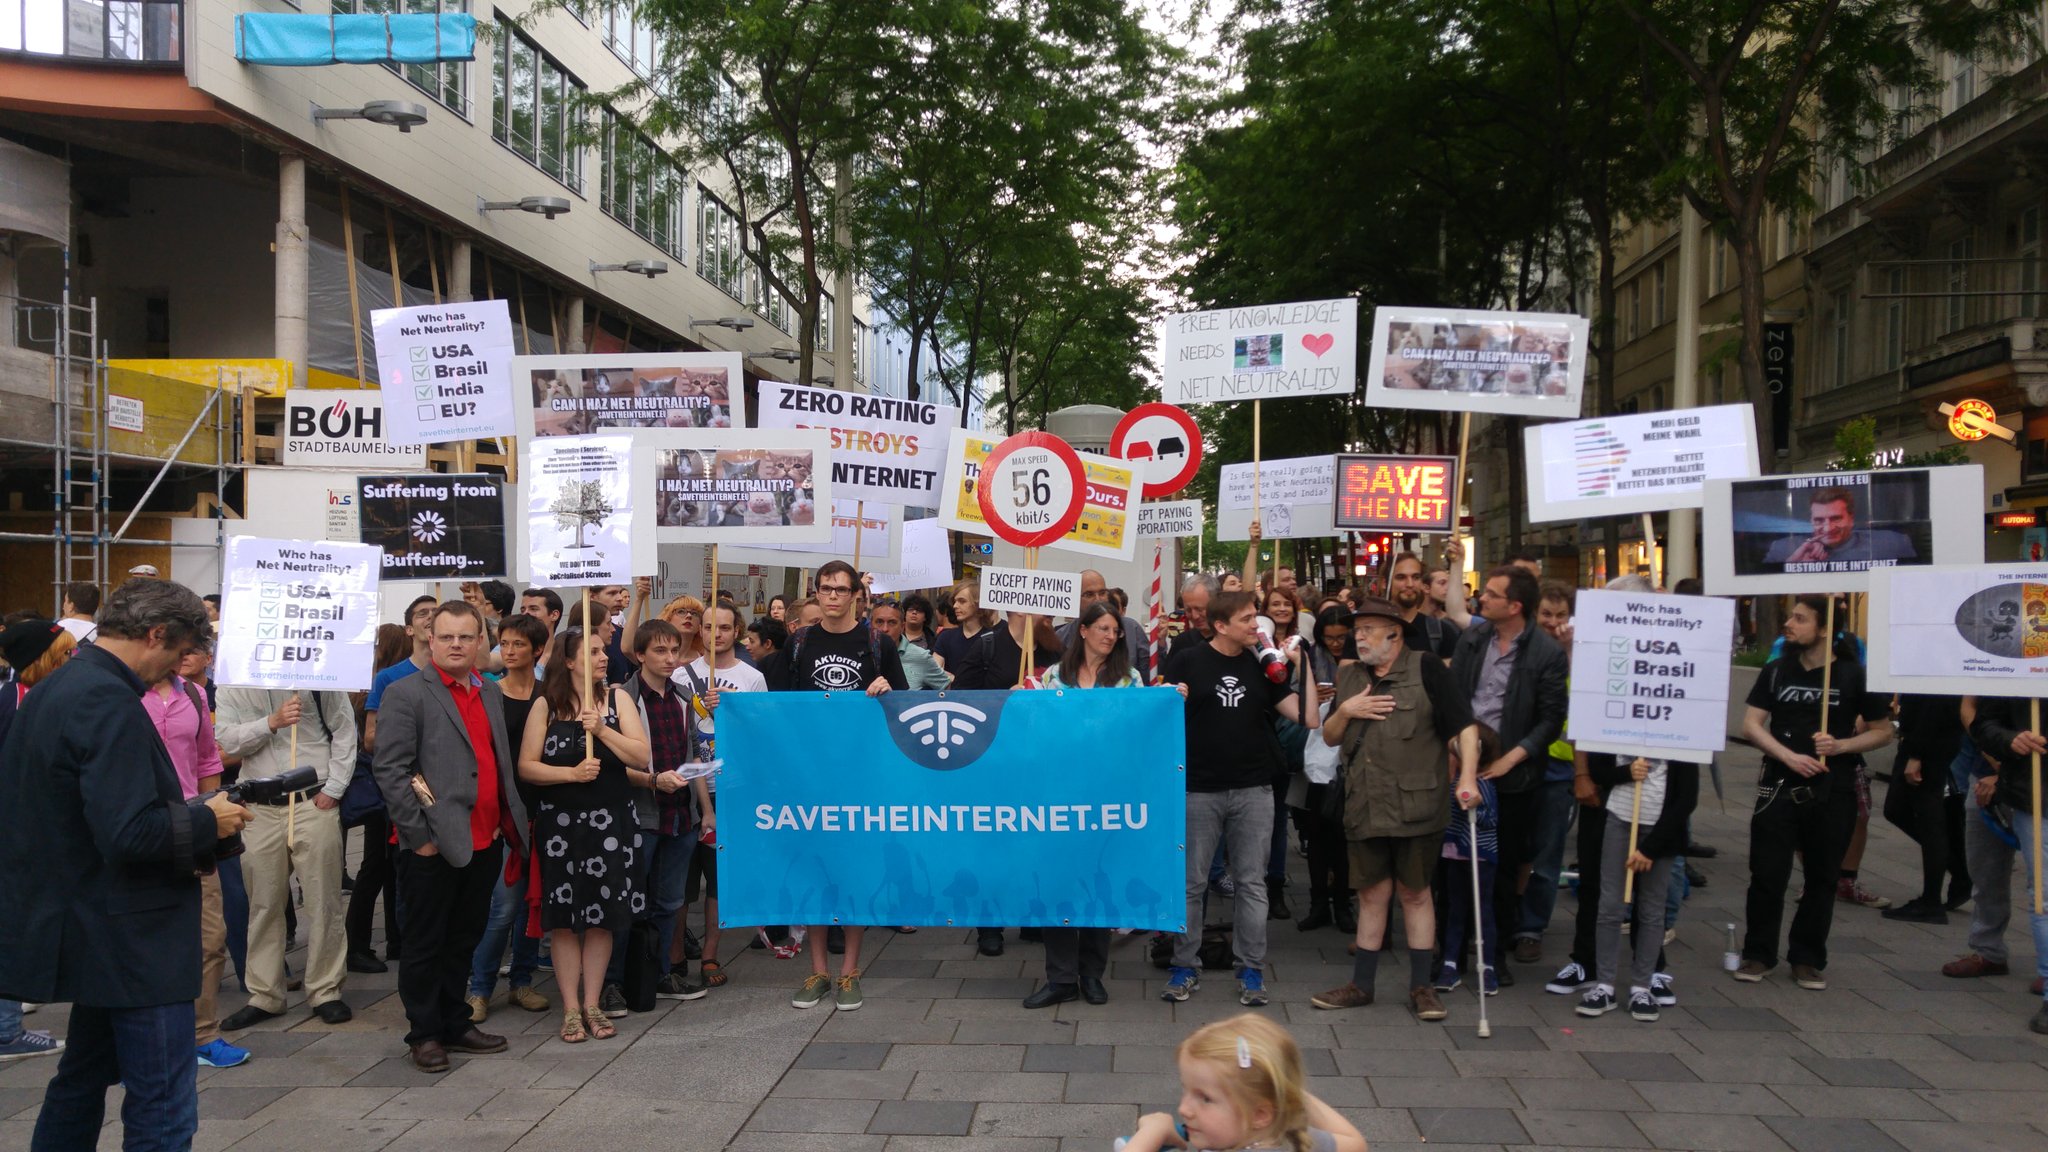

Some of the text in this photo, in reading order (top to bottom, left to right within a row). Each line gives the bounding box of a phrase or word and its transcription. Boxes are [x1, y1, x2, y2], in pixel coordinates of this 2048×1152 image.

[417, 312, 466, 323] Who has
[1179, 301, 1342, 334] FREE KNOWLEDGE
[400, 321, 486, 336] Net Neutrality?
[432, 344, 474, 359] USA
[1180, 344, 1225, 361] NEEDS
[1402, 348, 1551, 364] CAN I HAZ NET NEUTRALITY?
[434, 361, 488, 379] Brasil
[1768, 330, 1784, 395] zero
[438, 382, 484, 398] India
[1180, 366, 1340, 400] NET NEUTRALITY
[440, 402, 477, 418] EU?
[552, 396, 711, 412] CAN I HAZ NET NEUTRALITY?
[779, 388, 936, 426] ZERO RATING
[290, 398, 382, 438] BÖH
[598, 410, 667, 420] SAVETHEINTERNET.EU
[1677, 416, 1700, 426] GELD
[418, 425, 495, 438] savetheinternet.eu
[1643, 428, 1702, 441] MEINE WAHL
[289, 441, 422, 454] STADTBAUMEISTER
[796, 424, 919, 457] STROYS
[1012, 454, 1048, 466] MAX SPEED
[1674, 452, 1704, 462] RETTET
[832, 462, 937, 491] NTERNET
[965, 462, 981, 478] Th
[1242, 470, 1266, 479] Eurpe
[1270, 467, 1296, 477] really
[1300, 466, 1322, 476] going
[659, 479, 794, 492] I HAZ NET NEUTRALITY?
[1012, 468, 1050, 508] 56
[1290, 476, 1334, 486] Neutrality
[1346, 464, 1445, 496] SAVE
[1617, 480, 1645, 490] RETTET
[1648, 478, 1664, 487] DAS
[1788, 474, 1869, 488] DON'T LET THE EU
[364, 483, 497, 501] Suffering from
[678, 493, 750, 501] SAVETHEINTERNET.EU
[1301, 488, 1328, 497] India?
[960, 512, 985, 520] freewa
[1138, 506, 1192, 521] EPT PAYING
[1343, 497, 1448, 520] THE NET
[832, 518, 888, 531] TERNET
[1016, 510, 1050, 526] kbit/s
[1137, 520, 1193, 535] RPORATIONS
[278, 549, 332, 561] Who has
[383, 552, 484, 569] Buffering...
[256, 560, 351, 576] Net Neutrality?
[1785, 562, 1828, 573] DESTROY
[1830, 561, 1848, 571] THE
[990, 573, 1072, 593] EXCEPT PAYING
[287, 584, 332, 600] USA
[988, 590, 1071, 610] CORPORATIONS
[285, 604, 344, 621] Brasil
[1627, 603, 1682, 614] Who has
[1605, 614, 1702, 631] Net Neutrality?
[283, 625, 335, 641] India
[282, 646, 323, 662] EU?
[1635, 639, 1682, 656] USA
[814, 654, 862, 670] AKVorrat
[1634, 660, 1694, 678] Brasil
[250, 672, 338, 682] savetheinternet.eu
[1633, 682, 1685, 699] India
[1632, 704, 1672, 721] EU?
[755, 803, 1148, 832] SAVETHEINTERNET.EU
